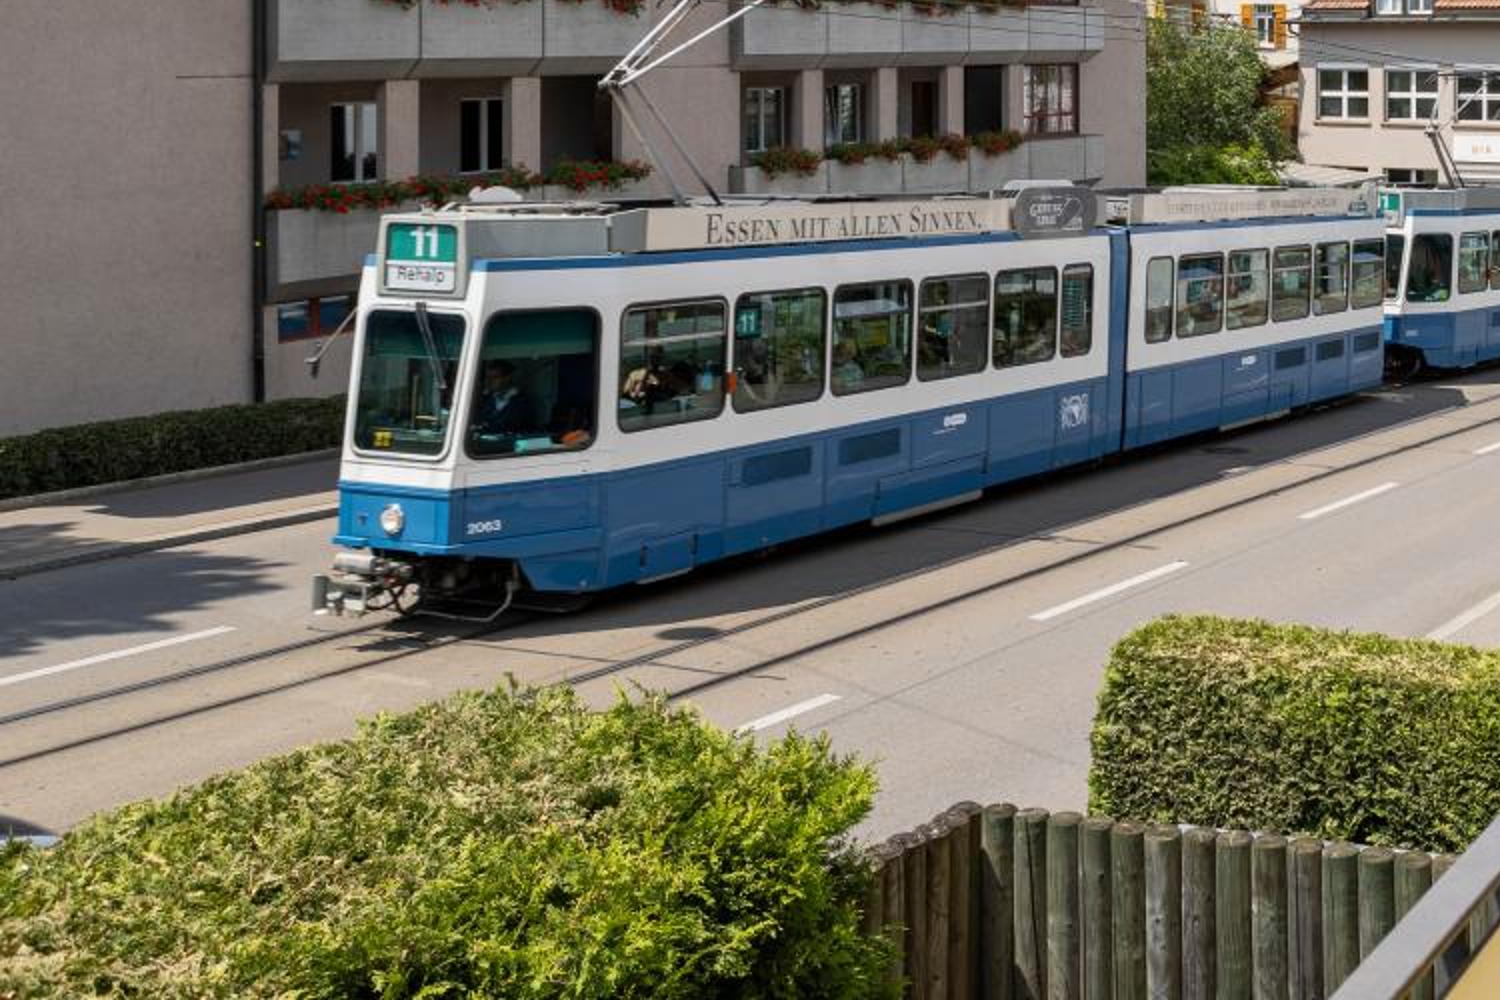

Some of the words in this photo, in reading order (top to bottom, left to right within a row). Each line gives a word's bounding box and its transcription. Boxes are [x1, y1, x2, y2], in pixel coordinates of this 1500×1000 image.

[409, 226, 439, 257] 11
[705, 213, 781, 244] ESSEN
[790, 217, 829, 239] MIT
[839, 214, 902, 237] ALLEN
[467, 520, 502, 535] 2063
